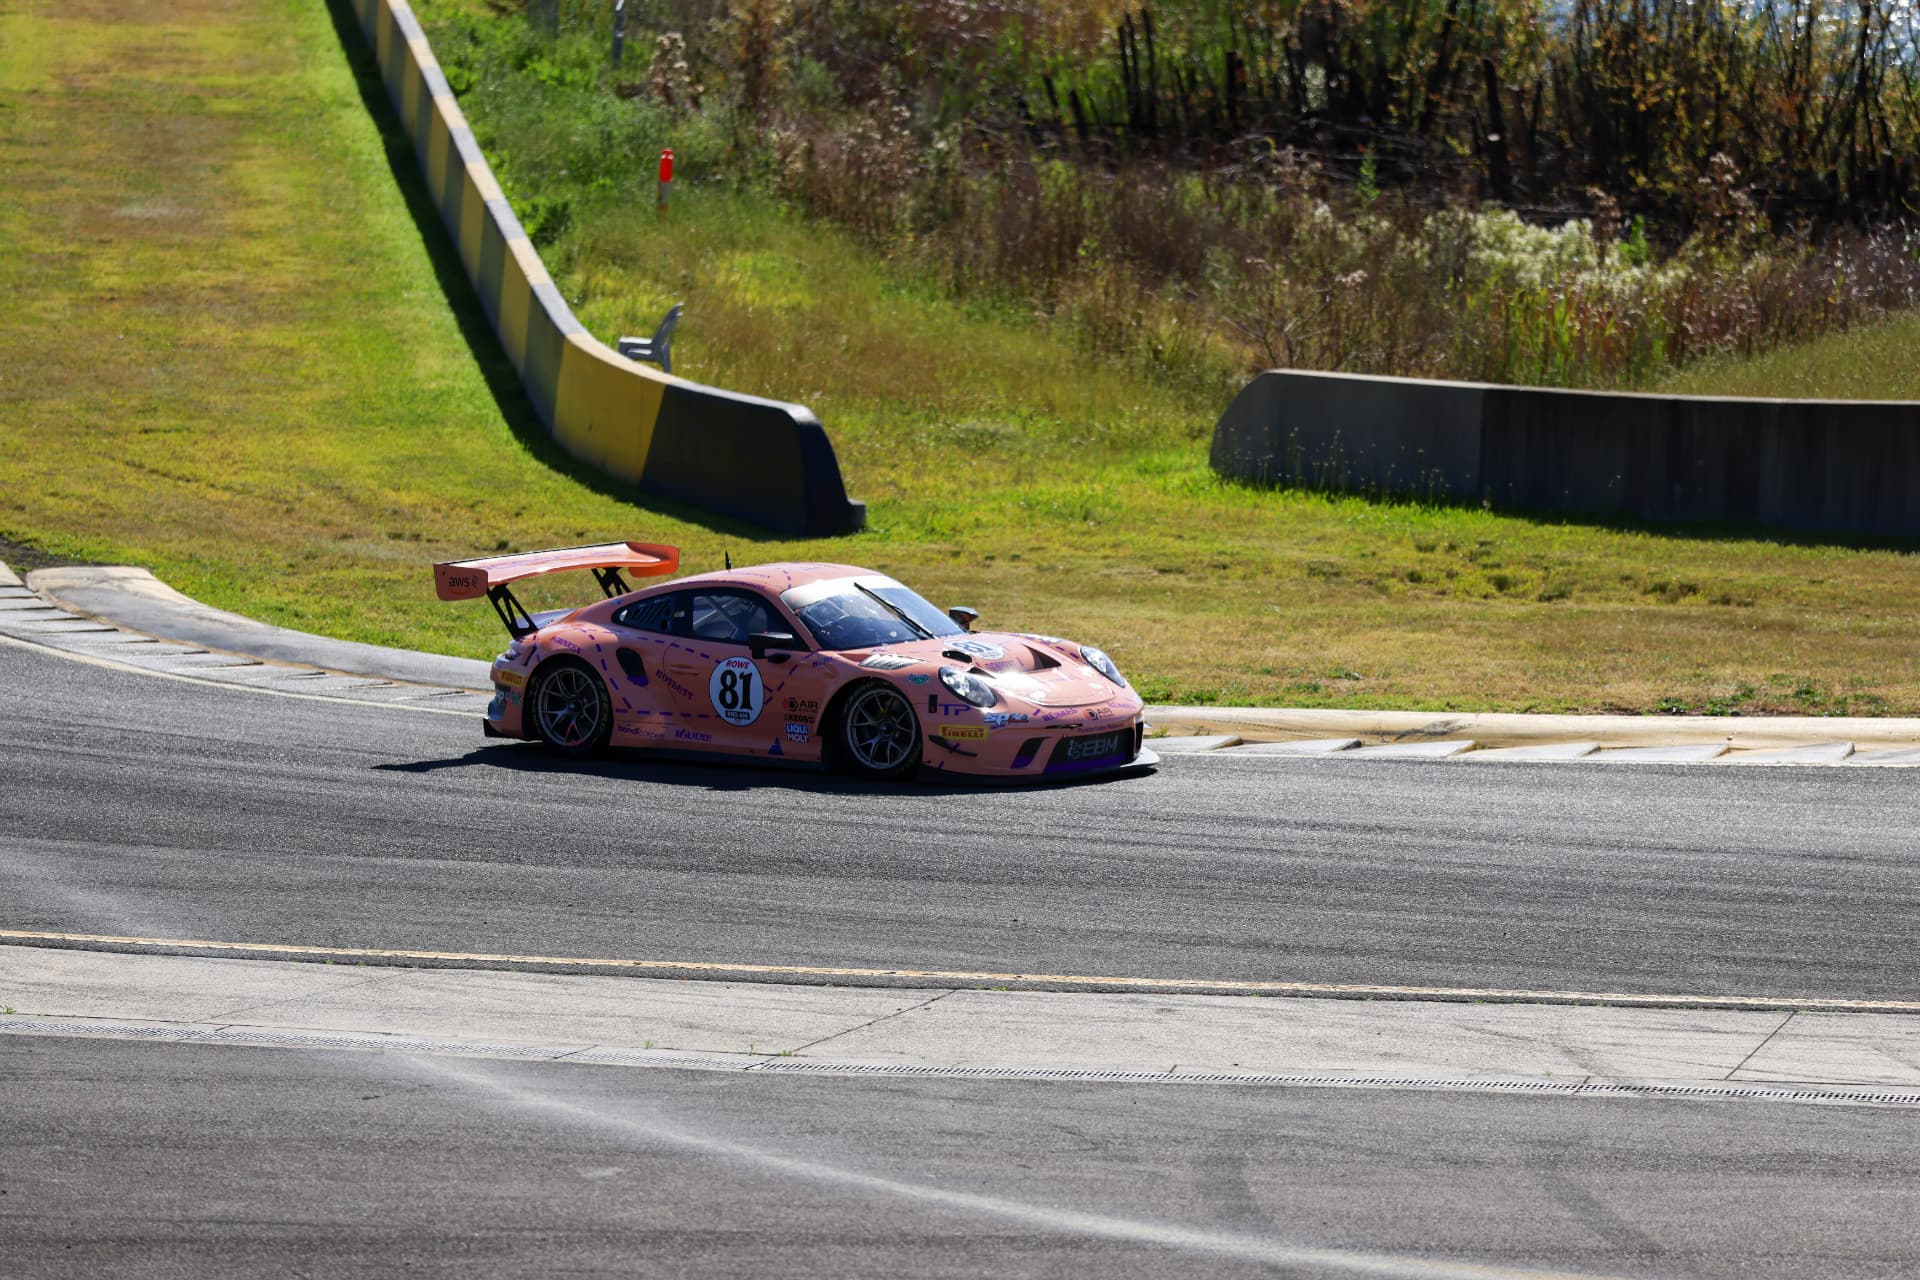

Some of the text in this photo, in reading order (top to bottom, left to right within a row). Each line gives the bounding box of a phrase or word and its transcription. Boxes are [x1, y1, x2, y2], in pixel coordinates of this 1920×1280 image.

[726, 660, 750, 669] ROWE
[718, 669, 752, 711] 81
[799, 699, 818, 710] AIR
[786, 724, 808, 734] LIQUI
[941, 726, 986, 739] PIRELLI
[787, 734, 809, 743] MOLY
